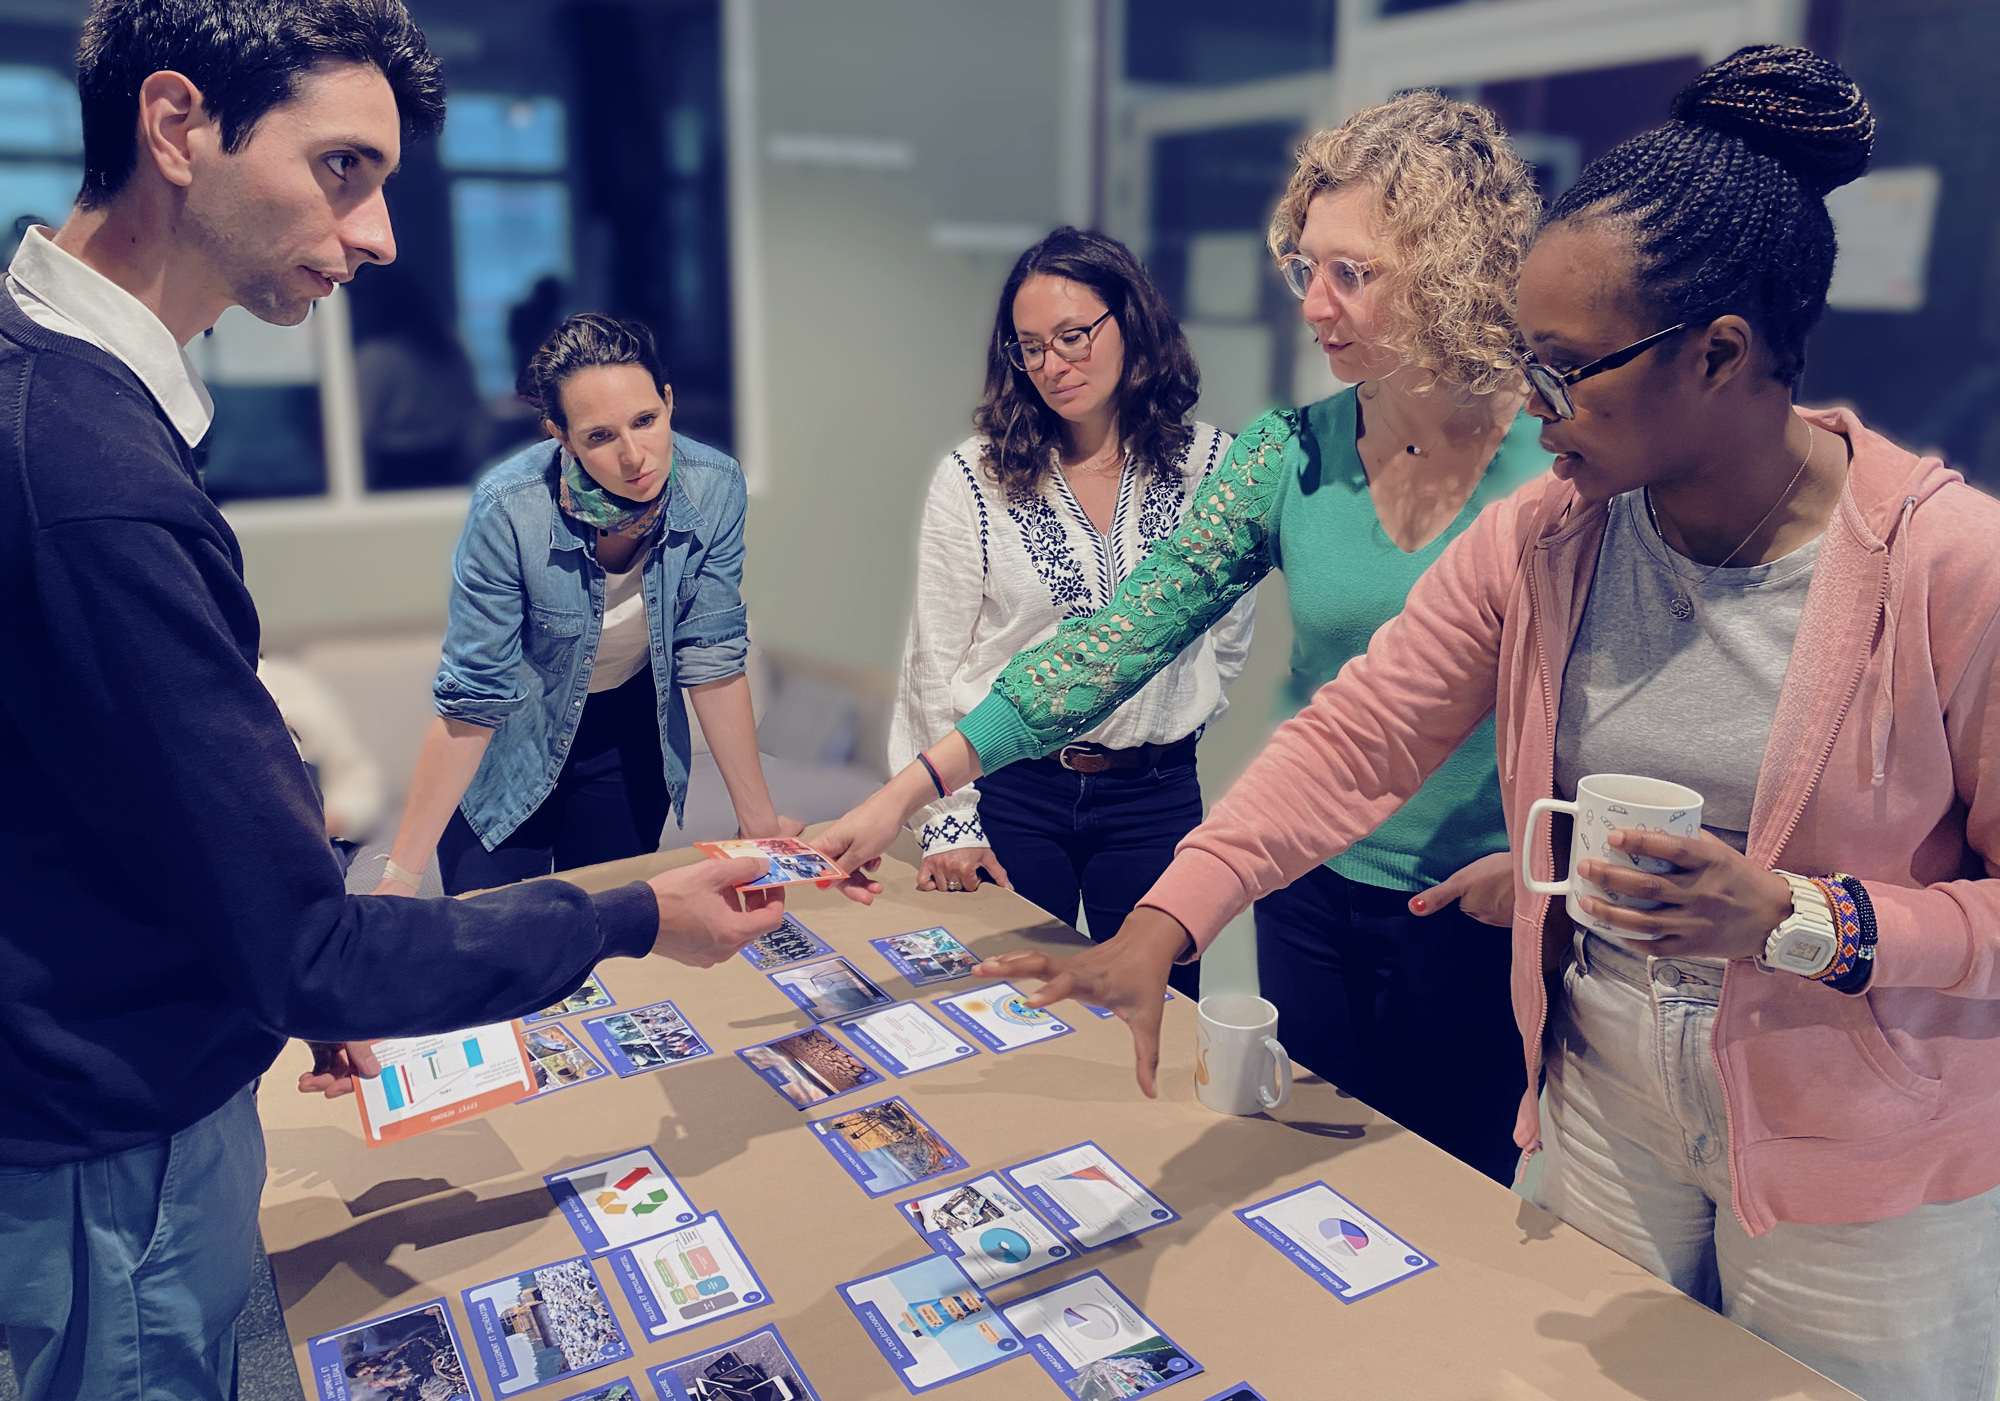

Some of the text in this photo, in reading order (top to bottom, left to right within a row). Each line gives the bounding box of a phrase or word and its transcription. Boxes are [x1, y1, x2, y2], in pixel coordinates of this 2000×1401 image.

[429, 1100, 478, 1123] EFFET REBOND
[618, 1254, 633, 1273] PARTIEL
[626, 1271, 644, 1295] RECYCLAGE
[641, 1300, 658, 1322] COLLECTE
[861, 1309, 890, 1338] ÉCOLOGIQUE
[475, 1301, 509, 1378] ENFOUISSEMENT ET INCINÉRATION
[882, 1335, 896, 1347] DOS
[891, 1348, 905, 1360] SAC
[1034, 1341, 1066, 1373] FABRICATION
[329, 1361, 343, 1385] ILLÉGALE
